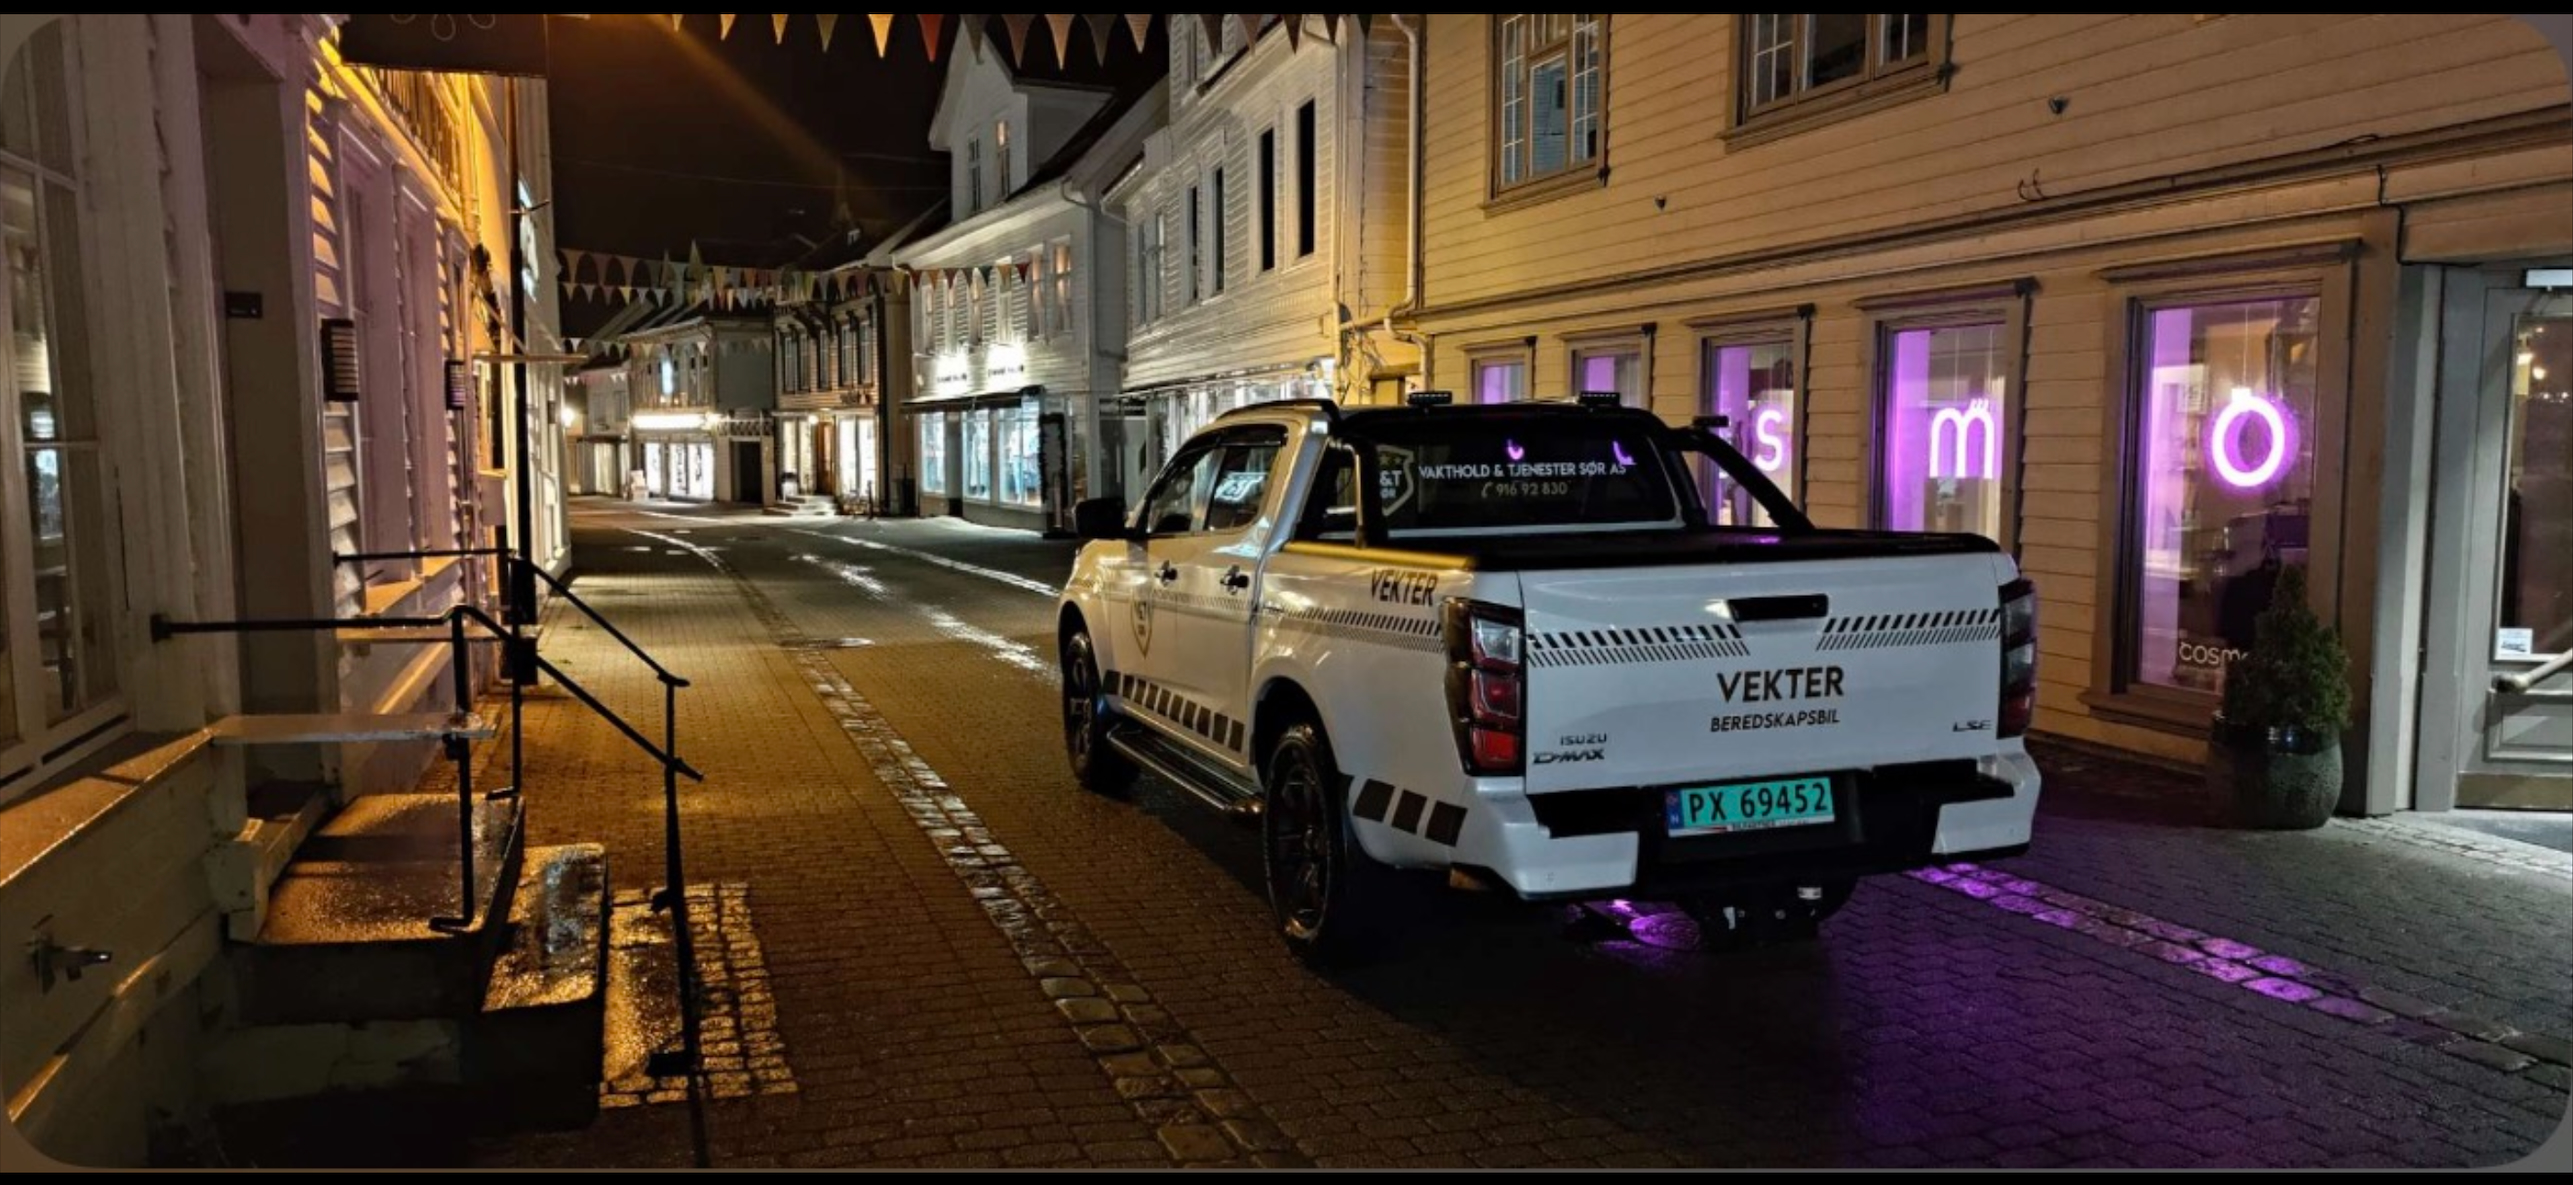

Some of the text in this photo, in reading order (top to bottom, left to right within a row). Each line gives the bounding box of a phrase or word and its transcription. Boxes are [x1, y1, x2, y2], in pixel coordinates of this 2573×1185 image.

[1379, 470, 1402, 487] &T
[1419, 461, 1627, 478] VAKTHOLD & TJENESTER SØR AS
[1496, 482, 1568, 496] 916 92 830
[1371, 569, 1439, 607] VEKTER
[2178, 641, 2249, 666] cosm
[1716, 665, 1845, 703] VEKTER
[1710, 708, 1840, 732] BEREDSKAPSBIL
[1953, 719, 1992, 732] LSE
[1560, 733, 1607, 746] ISUZU
[1688, 783, 1828, 823] PX 69452
